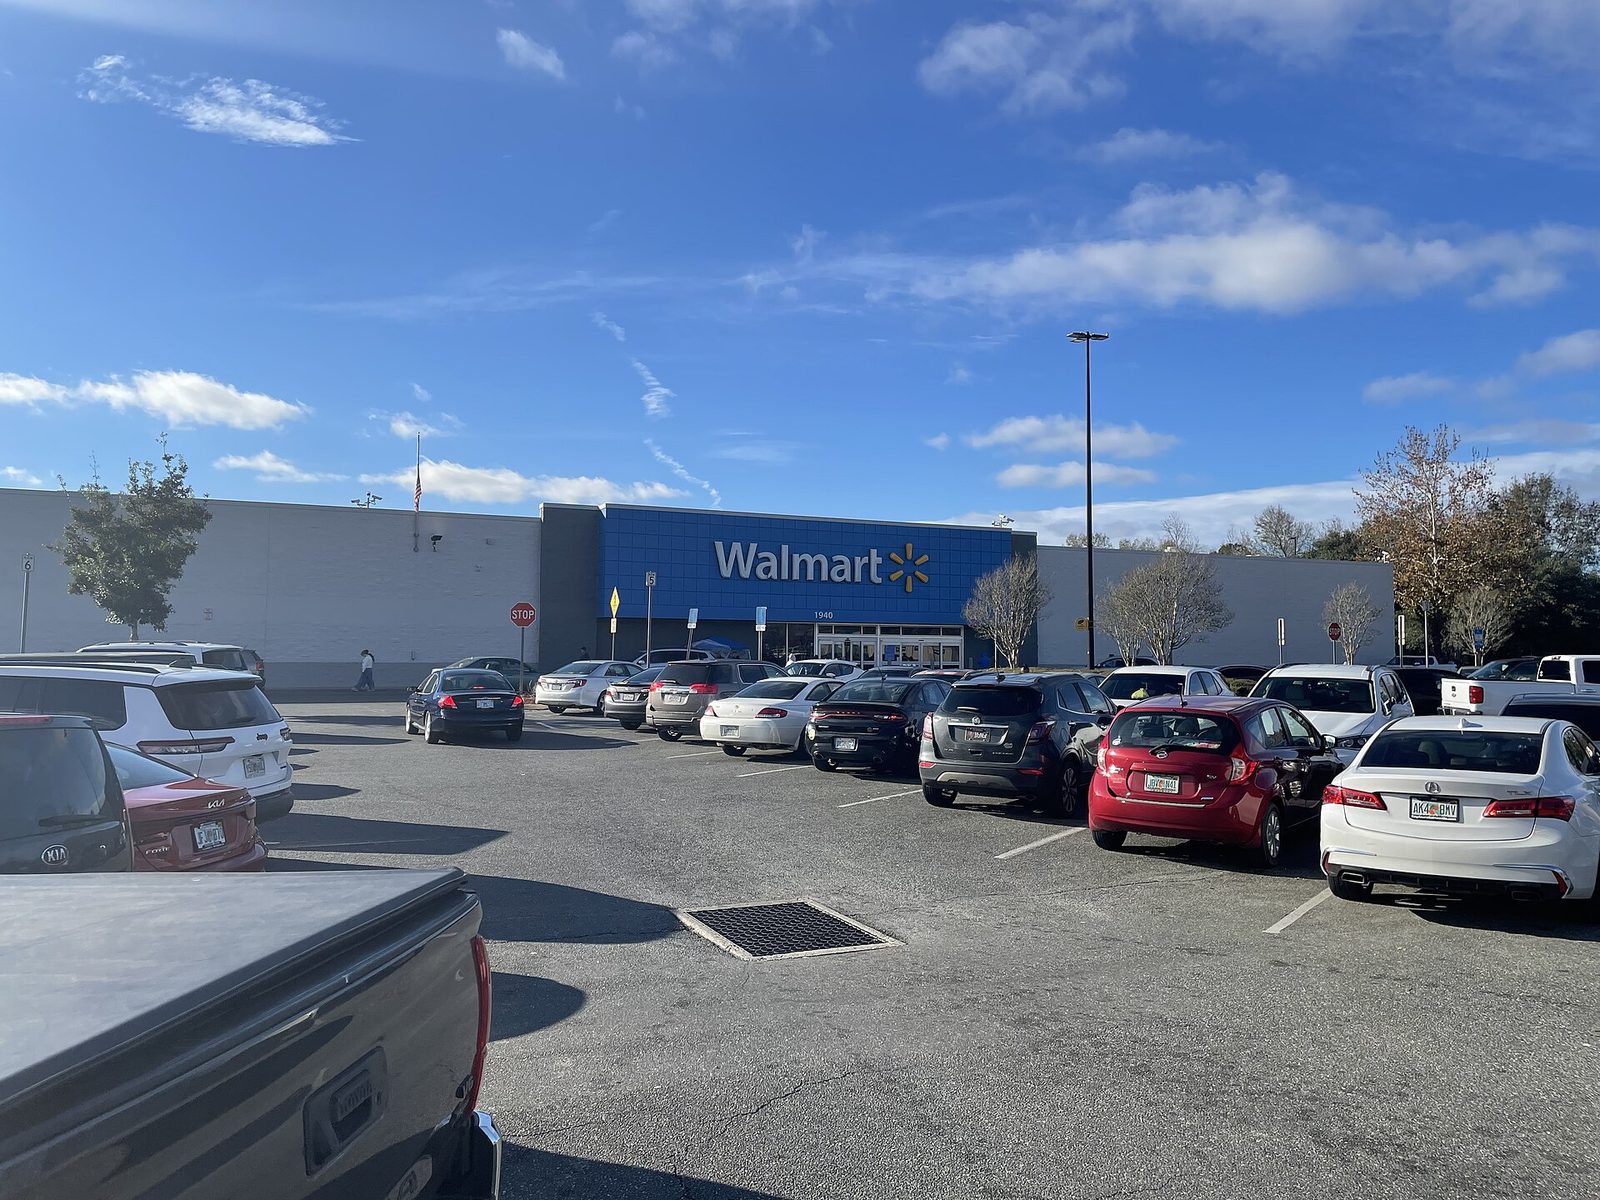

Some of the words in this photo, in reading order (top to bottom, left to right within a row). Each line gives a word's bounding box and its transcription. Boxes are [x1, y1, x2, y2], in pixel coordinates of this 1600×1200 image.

[25, 560, 31, 570] 6
[714, 541, 883, 584] Walmart
[649, 576, 655, 585] 5
[512, 609, 535, 620] STOP
[814, 611, 834, 620] 1940
[207, 799, 225, 809] KIA
[47, 848, 66, 862] KIA
